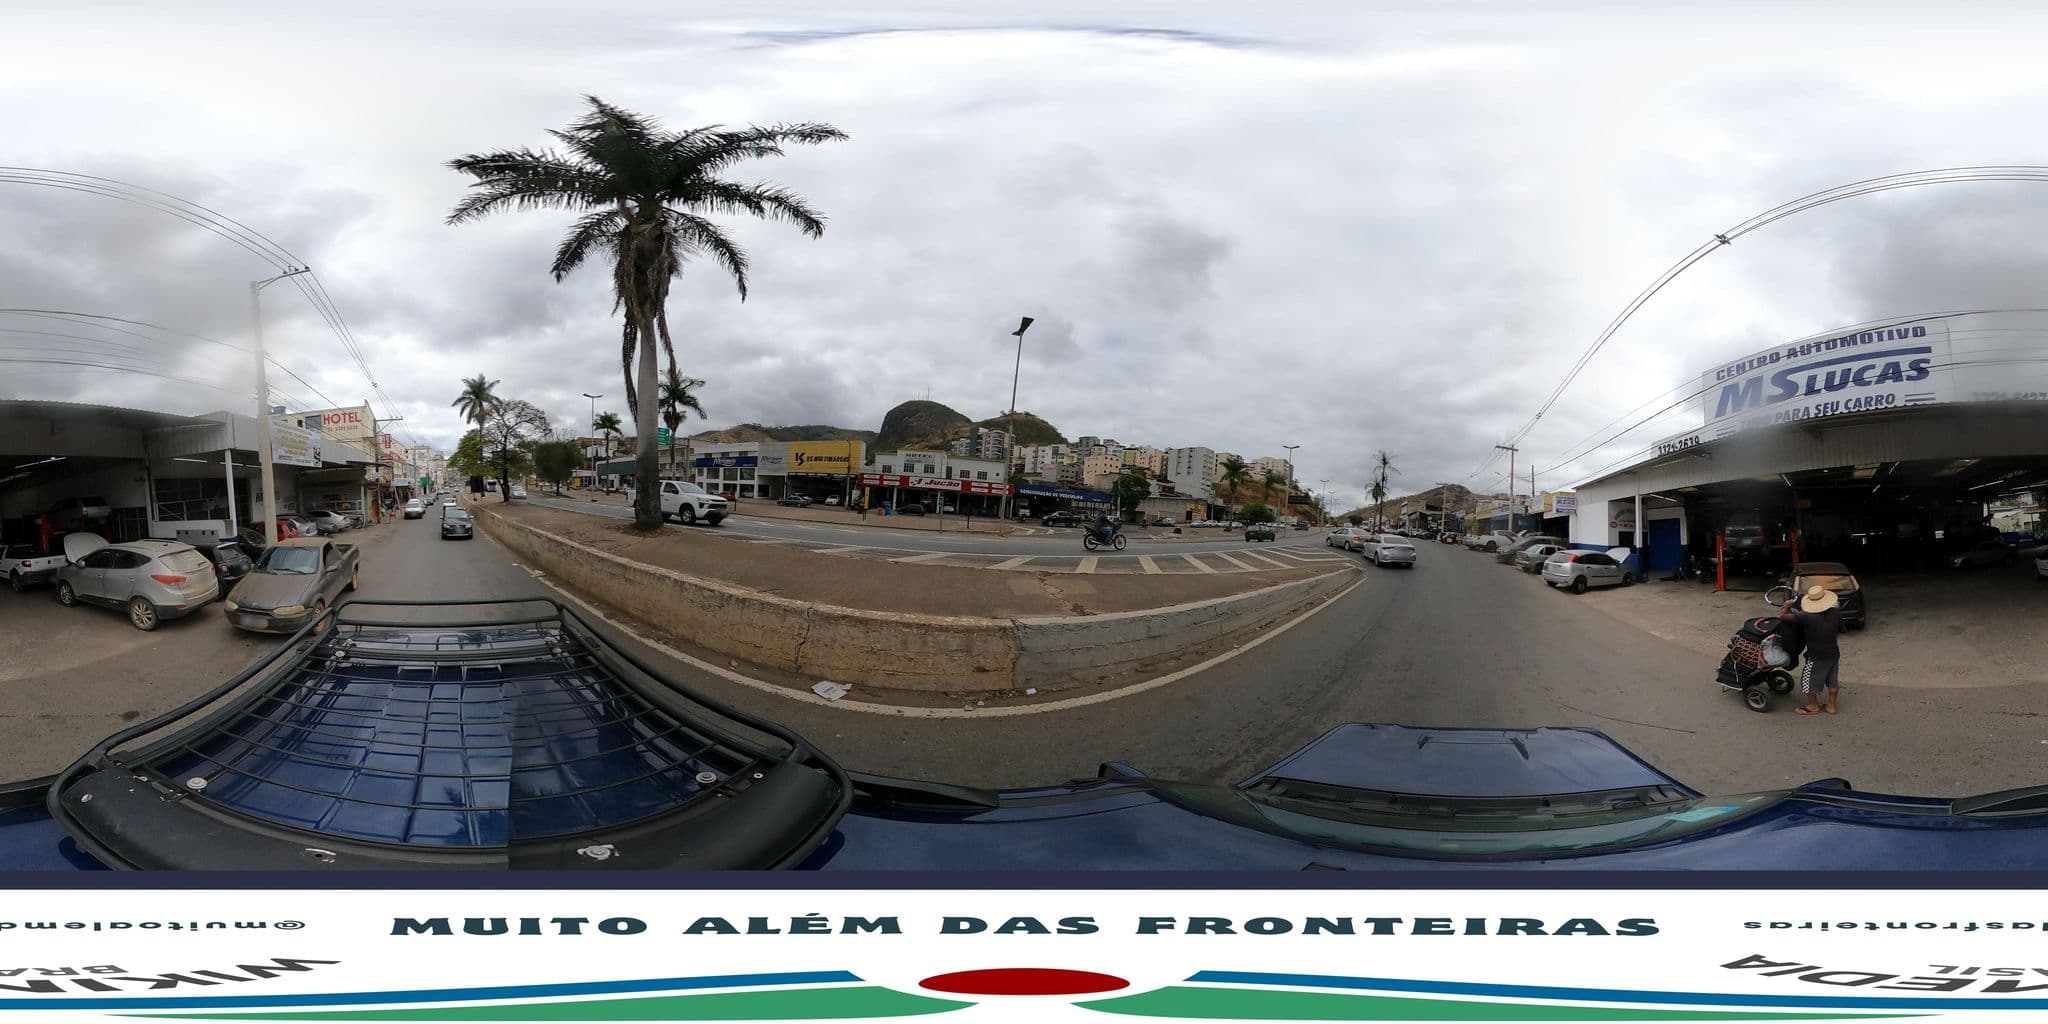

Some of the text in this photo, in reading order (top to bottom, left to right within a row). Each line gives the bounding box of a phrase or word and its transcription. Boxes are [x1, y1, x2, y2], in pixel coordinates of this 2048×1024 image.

[1715, 325, 1927, 381] CENTRO AUTOMOTIVO
[323, 411, 362, 426] HOTEL
[1774, 405, 1812, 426] PARA
[1814, 400, 1841, 418] SEU
[1843, 392, 1896, 413] CARRO
